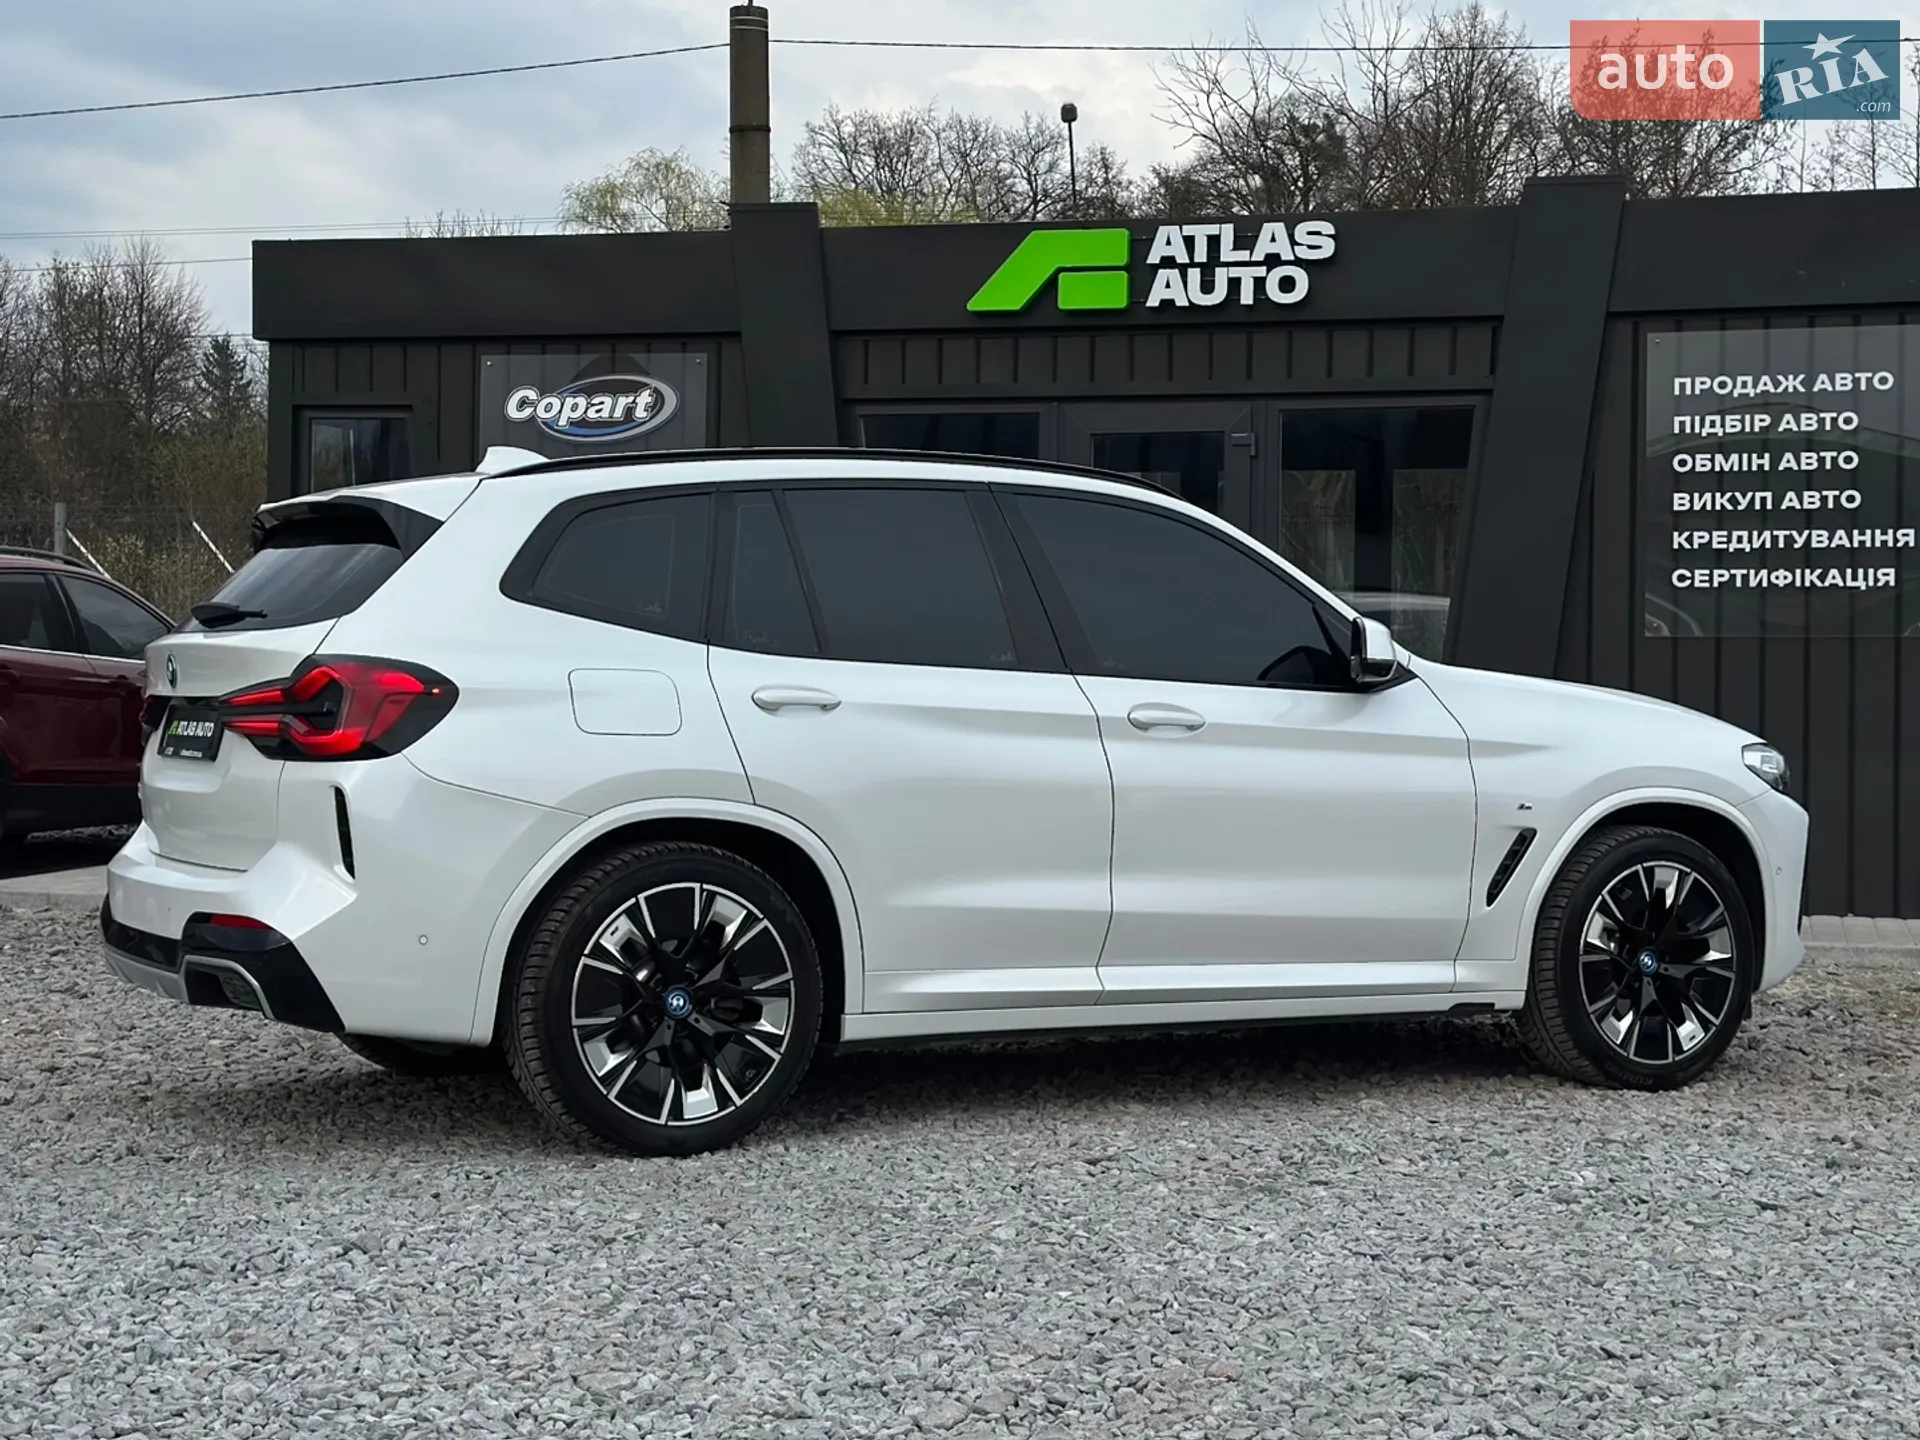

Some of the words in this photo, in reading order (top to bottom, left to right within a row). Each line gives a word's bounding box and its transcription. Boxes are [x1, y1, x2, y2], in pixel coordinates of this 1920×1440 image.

[1146, 220, 1336, 264] ATLAS
[1145, 265, 1309, 307] AUTO
[1673, 374, 1806, 398] ПРОДАЖ
[1812, 371, 1895, 392] АВТО
[505, 385, 655, 428] Copart
[1673, 413, 1772, 437] ПІДБІР
[1777, 411, 1859, 432] АВТО
[1672, 452, 1770, 473] ОБМІН
[1778, 450, 1859, 471] АВТО
[1673, 491, 1773, 511] ВИКУП
[1780, 489, 1862, 510] АВТО
[1673, 528, 1915, 552] КРЕДИТУВАННЯ
[1671, 567, 1896, 590] СЕРТИФІКАЦІЯ
